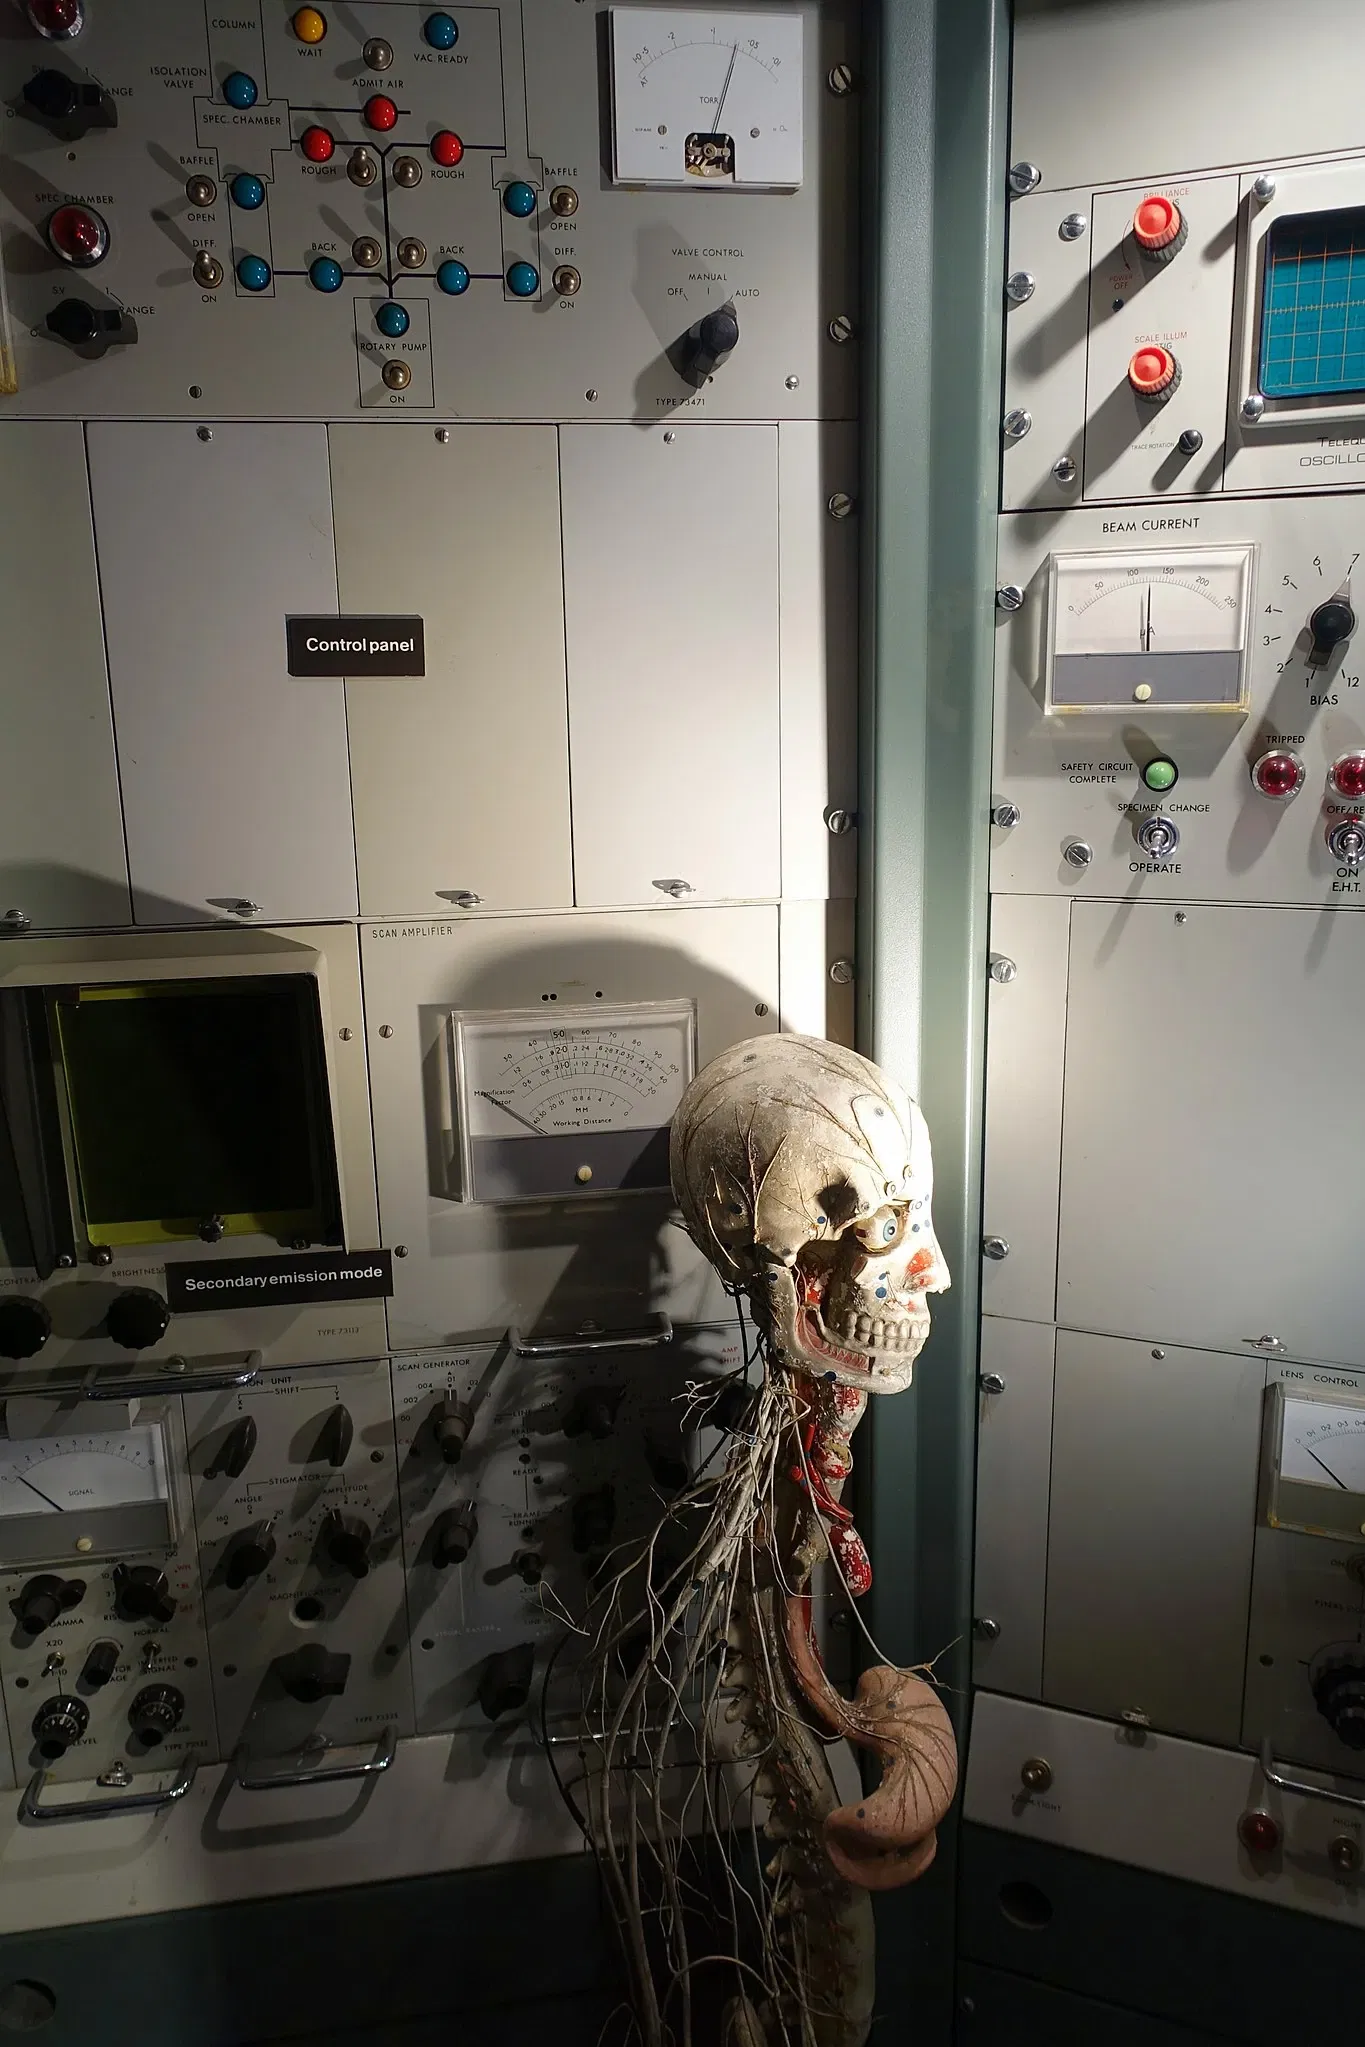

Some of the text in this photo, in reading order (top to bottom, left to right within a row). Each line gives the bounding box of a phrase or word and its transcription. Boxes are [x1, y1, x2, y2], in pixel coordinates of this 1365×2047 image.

[211, 19, 256, 29] COLUMN
[297, 48, 323, 57] WAIT
[437, 54, 469, 65] READY
[150, 66, 207, 77] ISOLATION
[163, 80, 194, 89] VALVE
[352, 78, 405, 90] ADMIT AIR
[700, 96, 719, 105] TORR
[232, 115, 282, 126] CHAMBER
[179, 156, 215, 166] BAFFLE
[301, 165, 337, 175] ROUGH
[430, 170, 465, 179] ROUGH
[544, 167, 578, 177] BAFFLE
[64, 194, 115, 205] CHAMBER
[187, 213, 216, 223] OPEN
[550, 222, 577, 231] OPEN
[192, 238, 217, 248] DIFF.
[311, 242, 337, 252] BACK
[439, 245, 465, 254] BACK
[554, 247, 577, 256] DIFF.
[671, 248, 745, 258] VALVE CONTROL
[688, 273, 727, 281] MANUAL
[1109, 274, 1133, 283] POWER
[1113, 282, 1129, 290] OFF
[667, 287, 684, 296] OFF
[735, 288, 760, 297] AUTO
[201, 294, 217, 303] ON
[559, 301, 575, 309] ON
[1134, 331, 1188, 344] SCALE ILLUM
[360, 342, 428, 352] ROTARY PUMP
[389, 395, 405, 404] ON
[655, 398, 705, 406] TYPE 73471
[1102, 517, 1200, 533] BEAM CURRENT
[1312, 555, 1321, 567] 6
[1351, 553, 1361, 565] 7
[1126, 568, 1139, 577] 100
[1162, 567, 1175, 576] 150
[1195, 575, 1210, 587] 200
[1281, 575, 1290, 586] 5
[1094, 581, 1104, 591] 50
[1223, 595, 1237, 609] 250
[1264, 604, 1273, 614] 4
[306, 637, 414, 654] Control panel
[1262, 635, 1270, 646] 3
[1276, 662, 1284, 673] 2
[1304, 677, 1310, 688] 1
[1346, 676, 1360, 688] 12
[1309, 694, 1339, 706] BIAS
[1265, 735, 1305, 745] TRIPPED
[1060, 762, 1133, 772] SAFETY CIRCUIT
[1069, 774, 1117, 784] COMPLETE
[1117, 802, 1210, 813] SPECIMEN CHANGE
[1128, 862, 1182, 874] OPERATE
[1336, 867, 1359, 878] ON
[1332, 881, 1361, 893] E.H.T.
[372, 926, 453, 939] SCAN AMPLIFIER
[474, 1088, 515, 1097] Magnification
[583, 1117, 612, 1125] Distance
[112, 1266, 166, 1278] BRIGHTNESS
[185, 1266, 383, 1291] Secondary emission mode
[317, 1328, 337, 1336] TYPE
[397, 1358, 471, 1372] SCAN GENERATOR
[271, 1376, 293, 1385] UNIT
[1280, 1369, 1359, 1388] LENS CONTROL
[274, 1386, 300, 1396] SHIFT
[512, 1467, 538, 1476] READY
[269, 1473, 321, 1486] STIGMATOR
[68, 1488, 95, 1496] SIGNAL
[322, 1484, 369, 1495] AMPLITUDE
[234, 1495, 263, 1504] ANGLE
[49, 1618, 84, 1628] GAMMA
